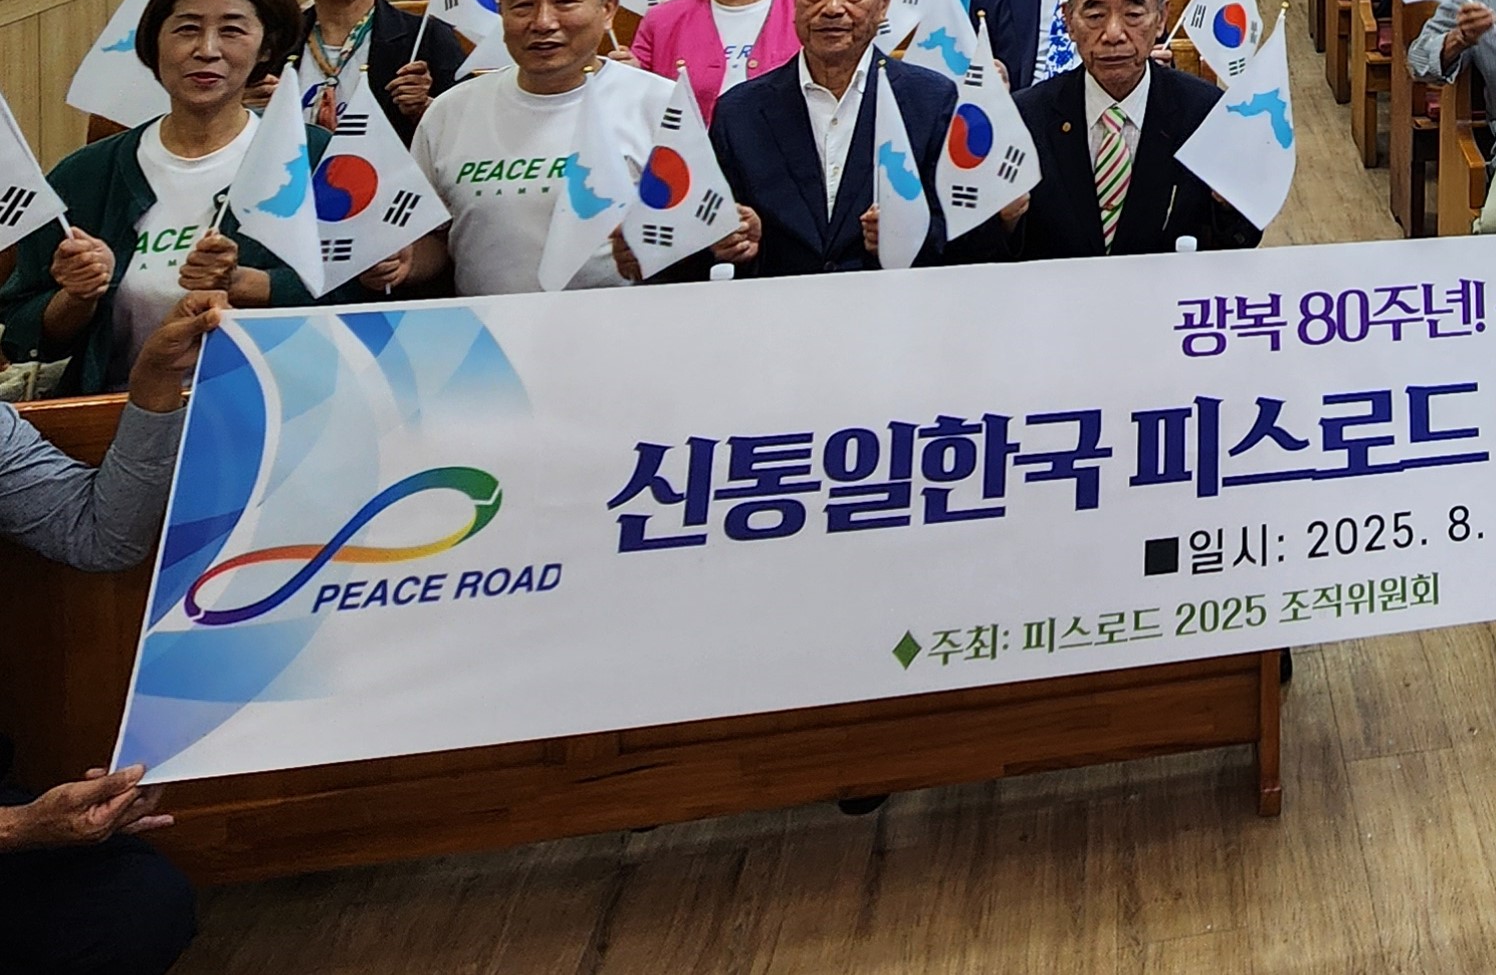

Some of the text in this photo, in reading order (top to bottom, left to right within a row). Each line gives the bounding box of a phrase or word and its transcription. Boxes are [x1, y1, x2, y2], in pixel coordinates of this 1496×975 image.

[456, 157, 546, 184] PEACE
[135, 225, 199, 254] ACE
[1174, 293, 1287, 357] 광복
[1297, 279, 1486, 345] 80주년!
[607, 409, 1113, 553] 신통일한국
[1129, 382, 1489, 498] 피스로드
[1190, 524, 1284, 575] 일시:
[1307, 511, 1427, 558] 2025.
[1448, 506, 1483, 541] 8.
[311, 563, 562, 613] PEACE ROAD
[928, 572, 1438, 666] 주최: 피스로드 2025 조직위원회
